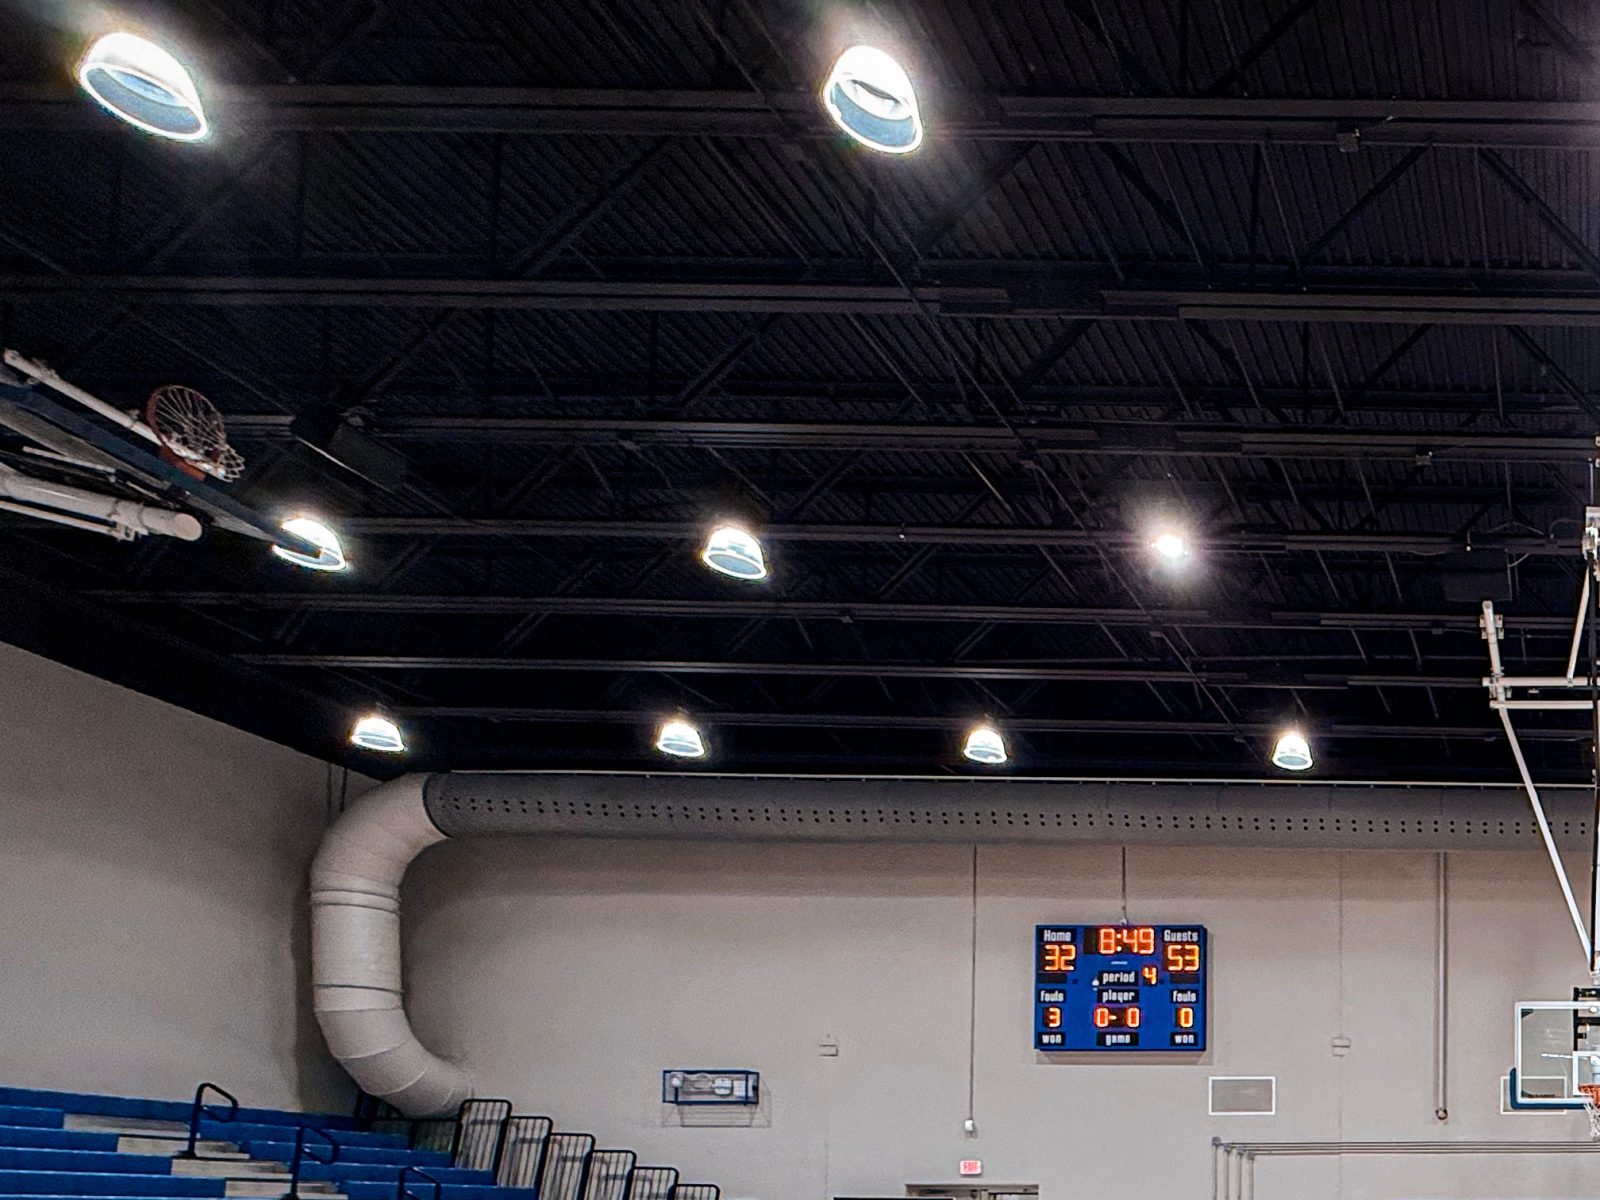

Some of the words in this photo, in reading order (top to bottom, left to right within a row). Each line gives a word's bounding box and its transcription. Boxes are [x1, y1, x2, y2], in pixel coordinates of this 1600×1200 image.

[1043, 929, 1072, 942] Home
[1099, 927, 1155, 955] 8:49
[1163, 929, 1199, 942] Guests
[1044, 944, 1076, 971] 32
[1167, 944, 1200, 971] 53
[1102, 971, 1135, 985] period
[1143, 966, 1157, 985] 4
[1040, 990, 1065, 1002] fouls
[1102, 989, 1135, 1004] player
[1172, 990, 1197, 1003] fouls
[1049, 1007, 1061, 1028] 3
[1180, 1007, 1194, 1028] 0
[1042, 1034, 1062, 1044] won
[1105, 1034, 1131, 1046] game
[1174, 1034, 1195, 1044] won
